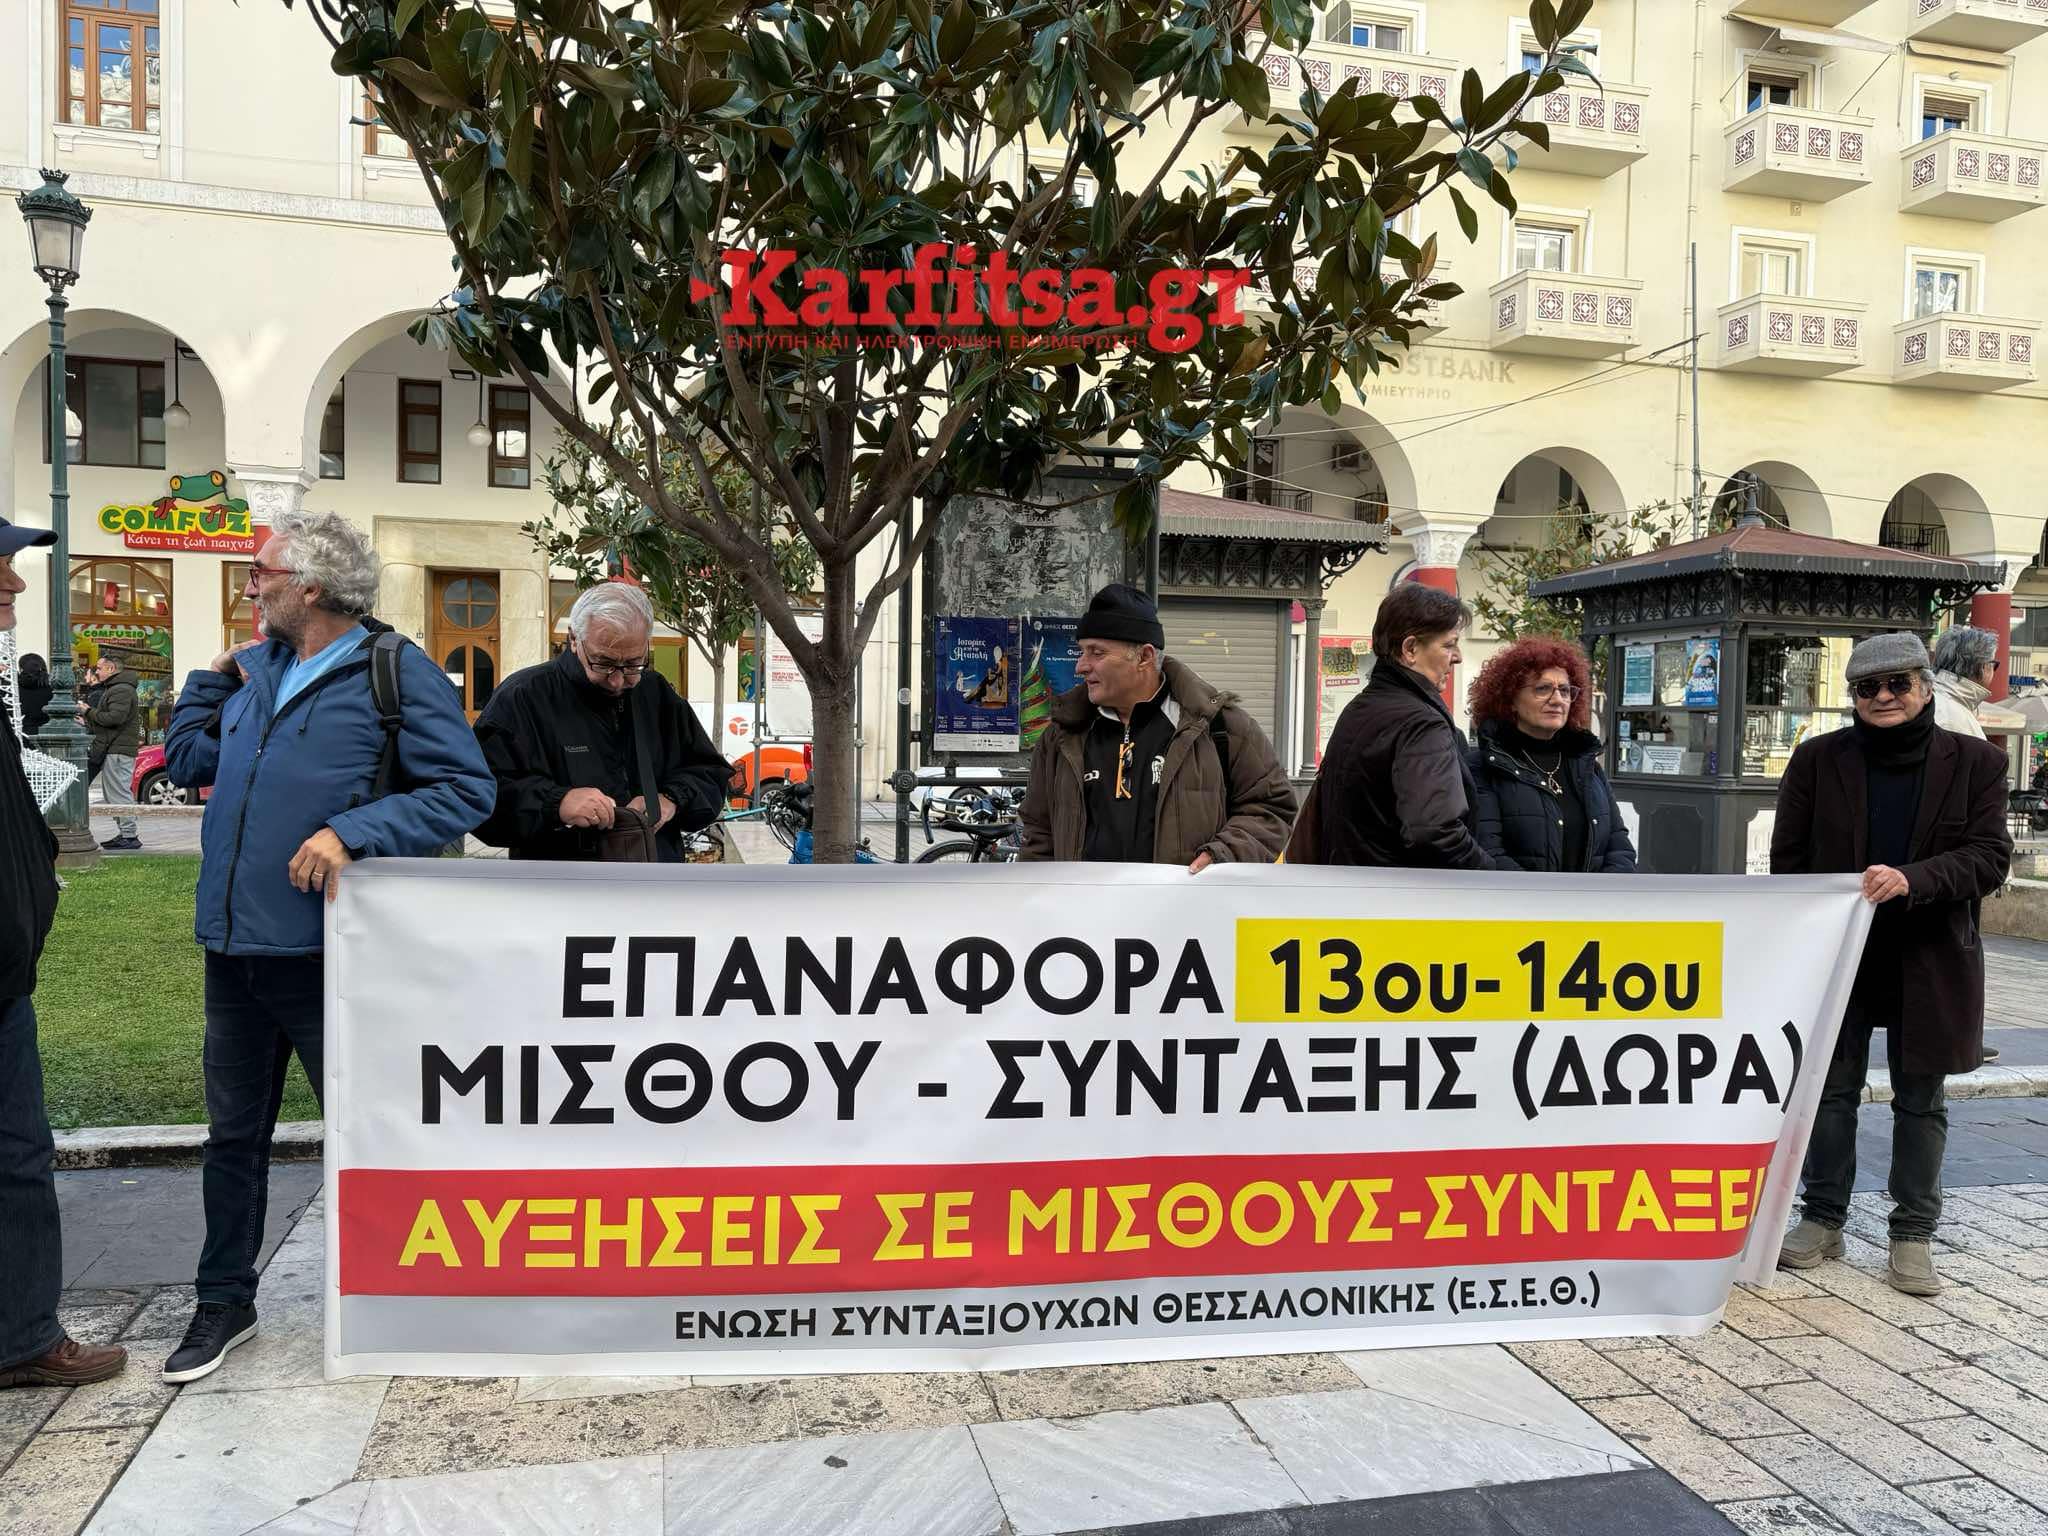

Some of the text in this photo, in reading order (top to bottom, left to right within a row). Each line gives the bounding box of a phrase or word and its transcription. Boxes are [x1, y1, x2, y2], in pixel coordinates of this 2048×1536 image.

[128, 533, 161, 545] Κάνει
[166, 537, 179, 546] τη
[184, 535, 207, 549] ζωή
[83, 629, 145, 638] COMFUZIO
[563, 937, 1700, 1018] ΕΠΑΝΑΦΟΡΑ 13ου-14ου
[421, 1020, 1803, 1125] ΜΙΣΘΟΥ - ΣΥΝΤΑΞΗΣ (ΔΩΡΑ)
[399, 1194, 842, 1268] ΑΥΞΗΣΕΙΣ
[873, 1191, 974, 1261] ΣΕ
[674, 1270, 1601, 1340] ΕΝΩΣΗ ΣΥΝΤΑΞΙΟΥΧΩΝ ΘΕΣΣΑΛΟΝΙΚΗΣ (Ε.Σ.Ε.Θ.)
